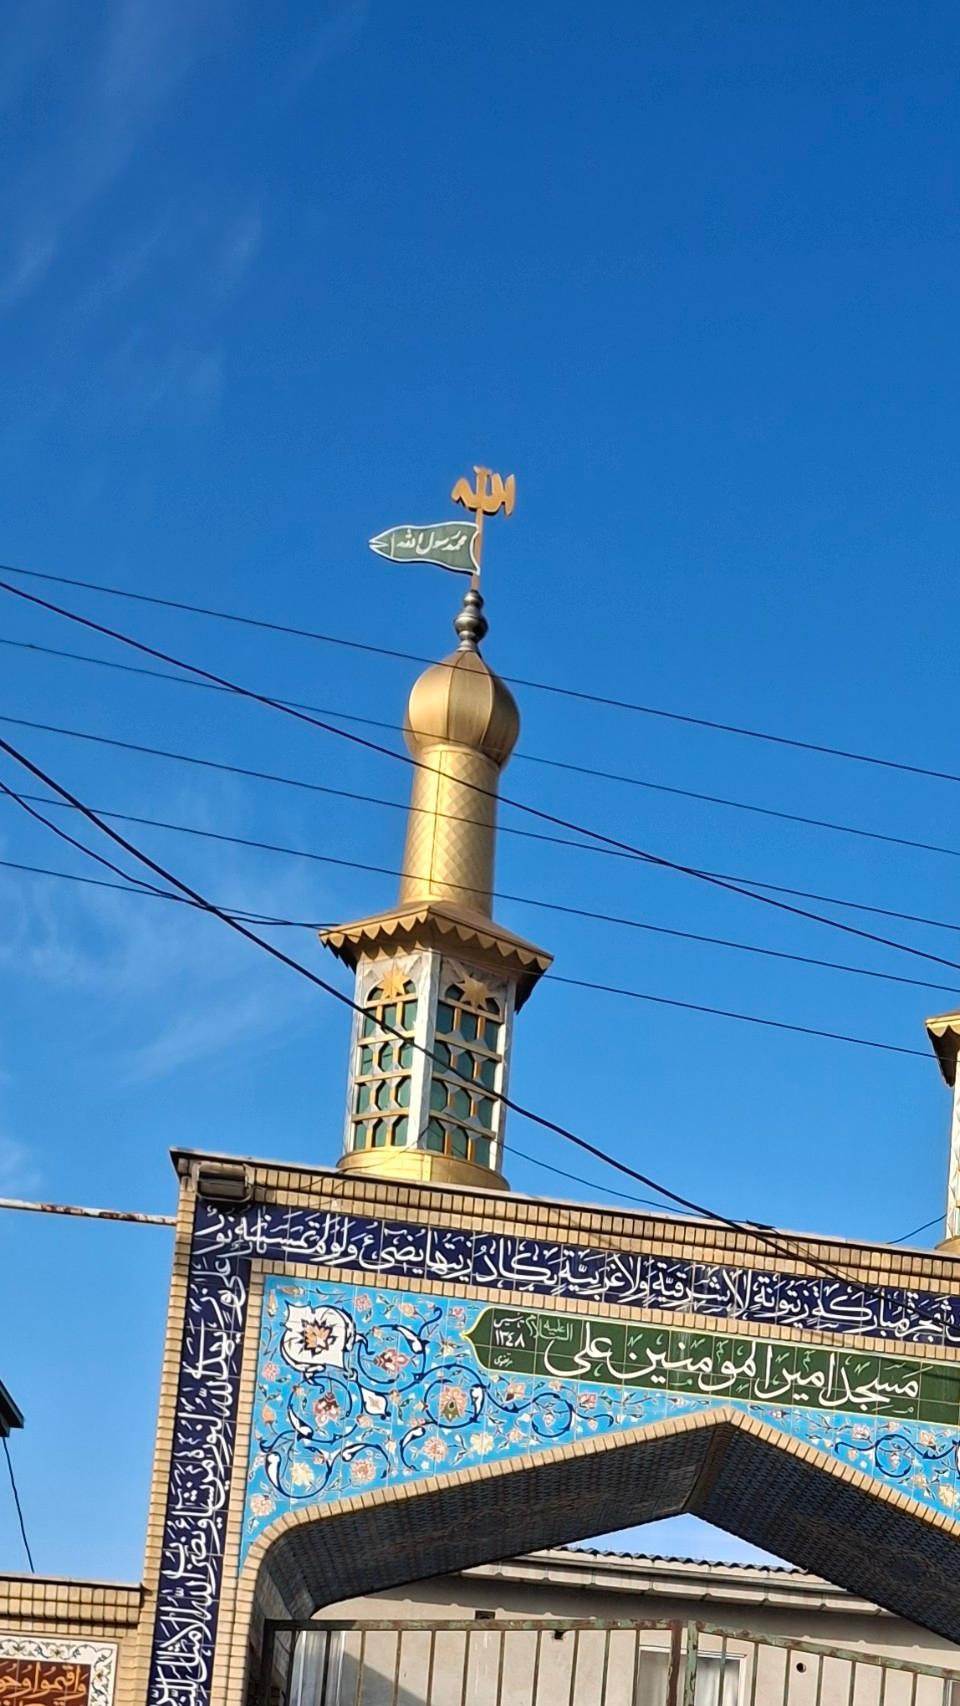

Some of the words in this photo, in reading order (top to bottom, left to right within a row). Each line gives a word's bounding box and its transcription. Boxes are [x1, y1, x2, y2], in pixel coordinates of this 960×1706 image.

[451, 465, 516, 517] الله
[544, 1322, 613, 1378] علی
[819, 1366, 919, 1411] مسجد
